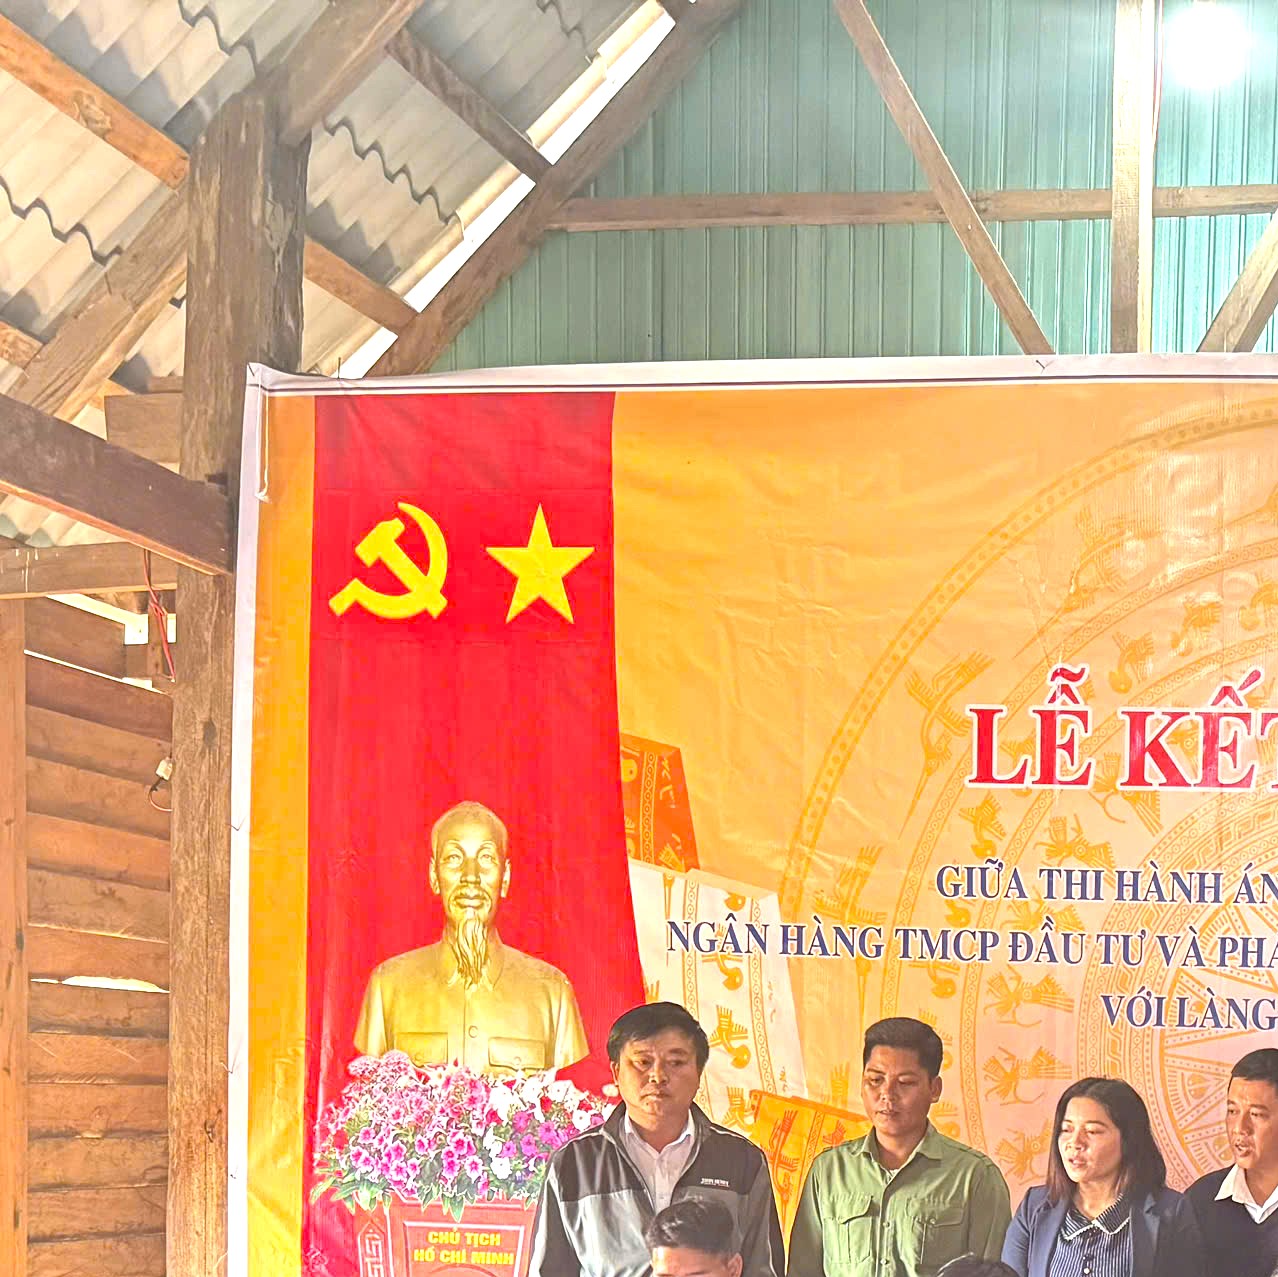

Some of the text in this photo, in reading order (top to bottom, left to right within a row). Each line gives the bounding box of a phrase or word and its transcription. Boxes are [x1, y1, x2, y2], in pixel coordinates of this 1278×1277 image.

[966, 662, 1096, 789] LỄ
[936, 859, 1027, 899] GIỮA
[1040, 867, 1101, 900] THI
[1115, 860, 1222, 904] HÀNH
[666, 913, 769, 957] NGÂN
[780, 916, 886, 960] HÀNG
[895, 927, 999, 962] TMCP
[1008, 919, 1086, 965] ĐẦU
[1096, 930, 1148, 966] TƯ
[1155, 926, 1205, 969] VÀ
[1100, 990, 1166, 1028] VỚI
[1168, 987, 1278, 1031] LÀNG
[428, 1226, 502, 1248] CHỦ TỊCH
[439, 1248, 467, 1264] CHÍ
[471, 1251, 515, 1265] MINH
